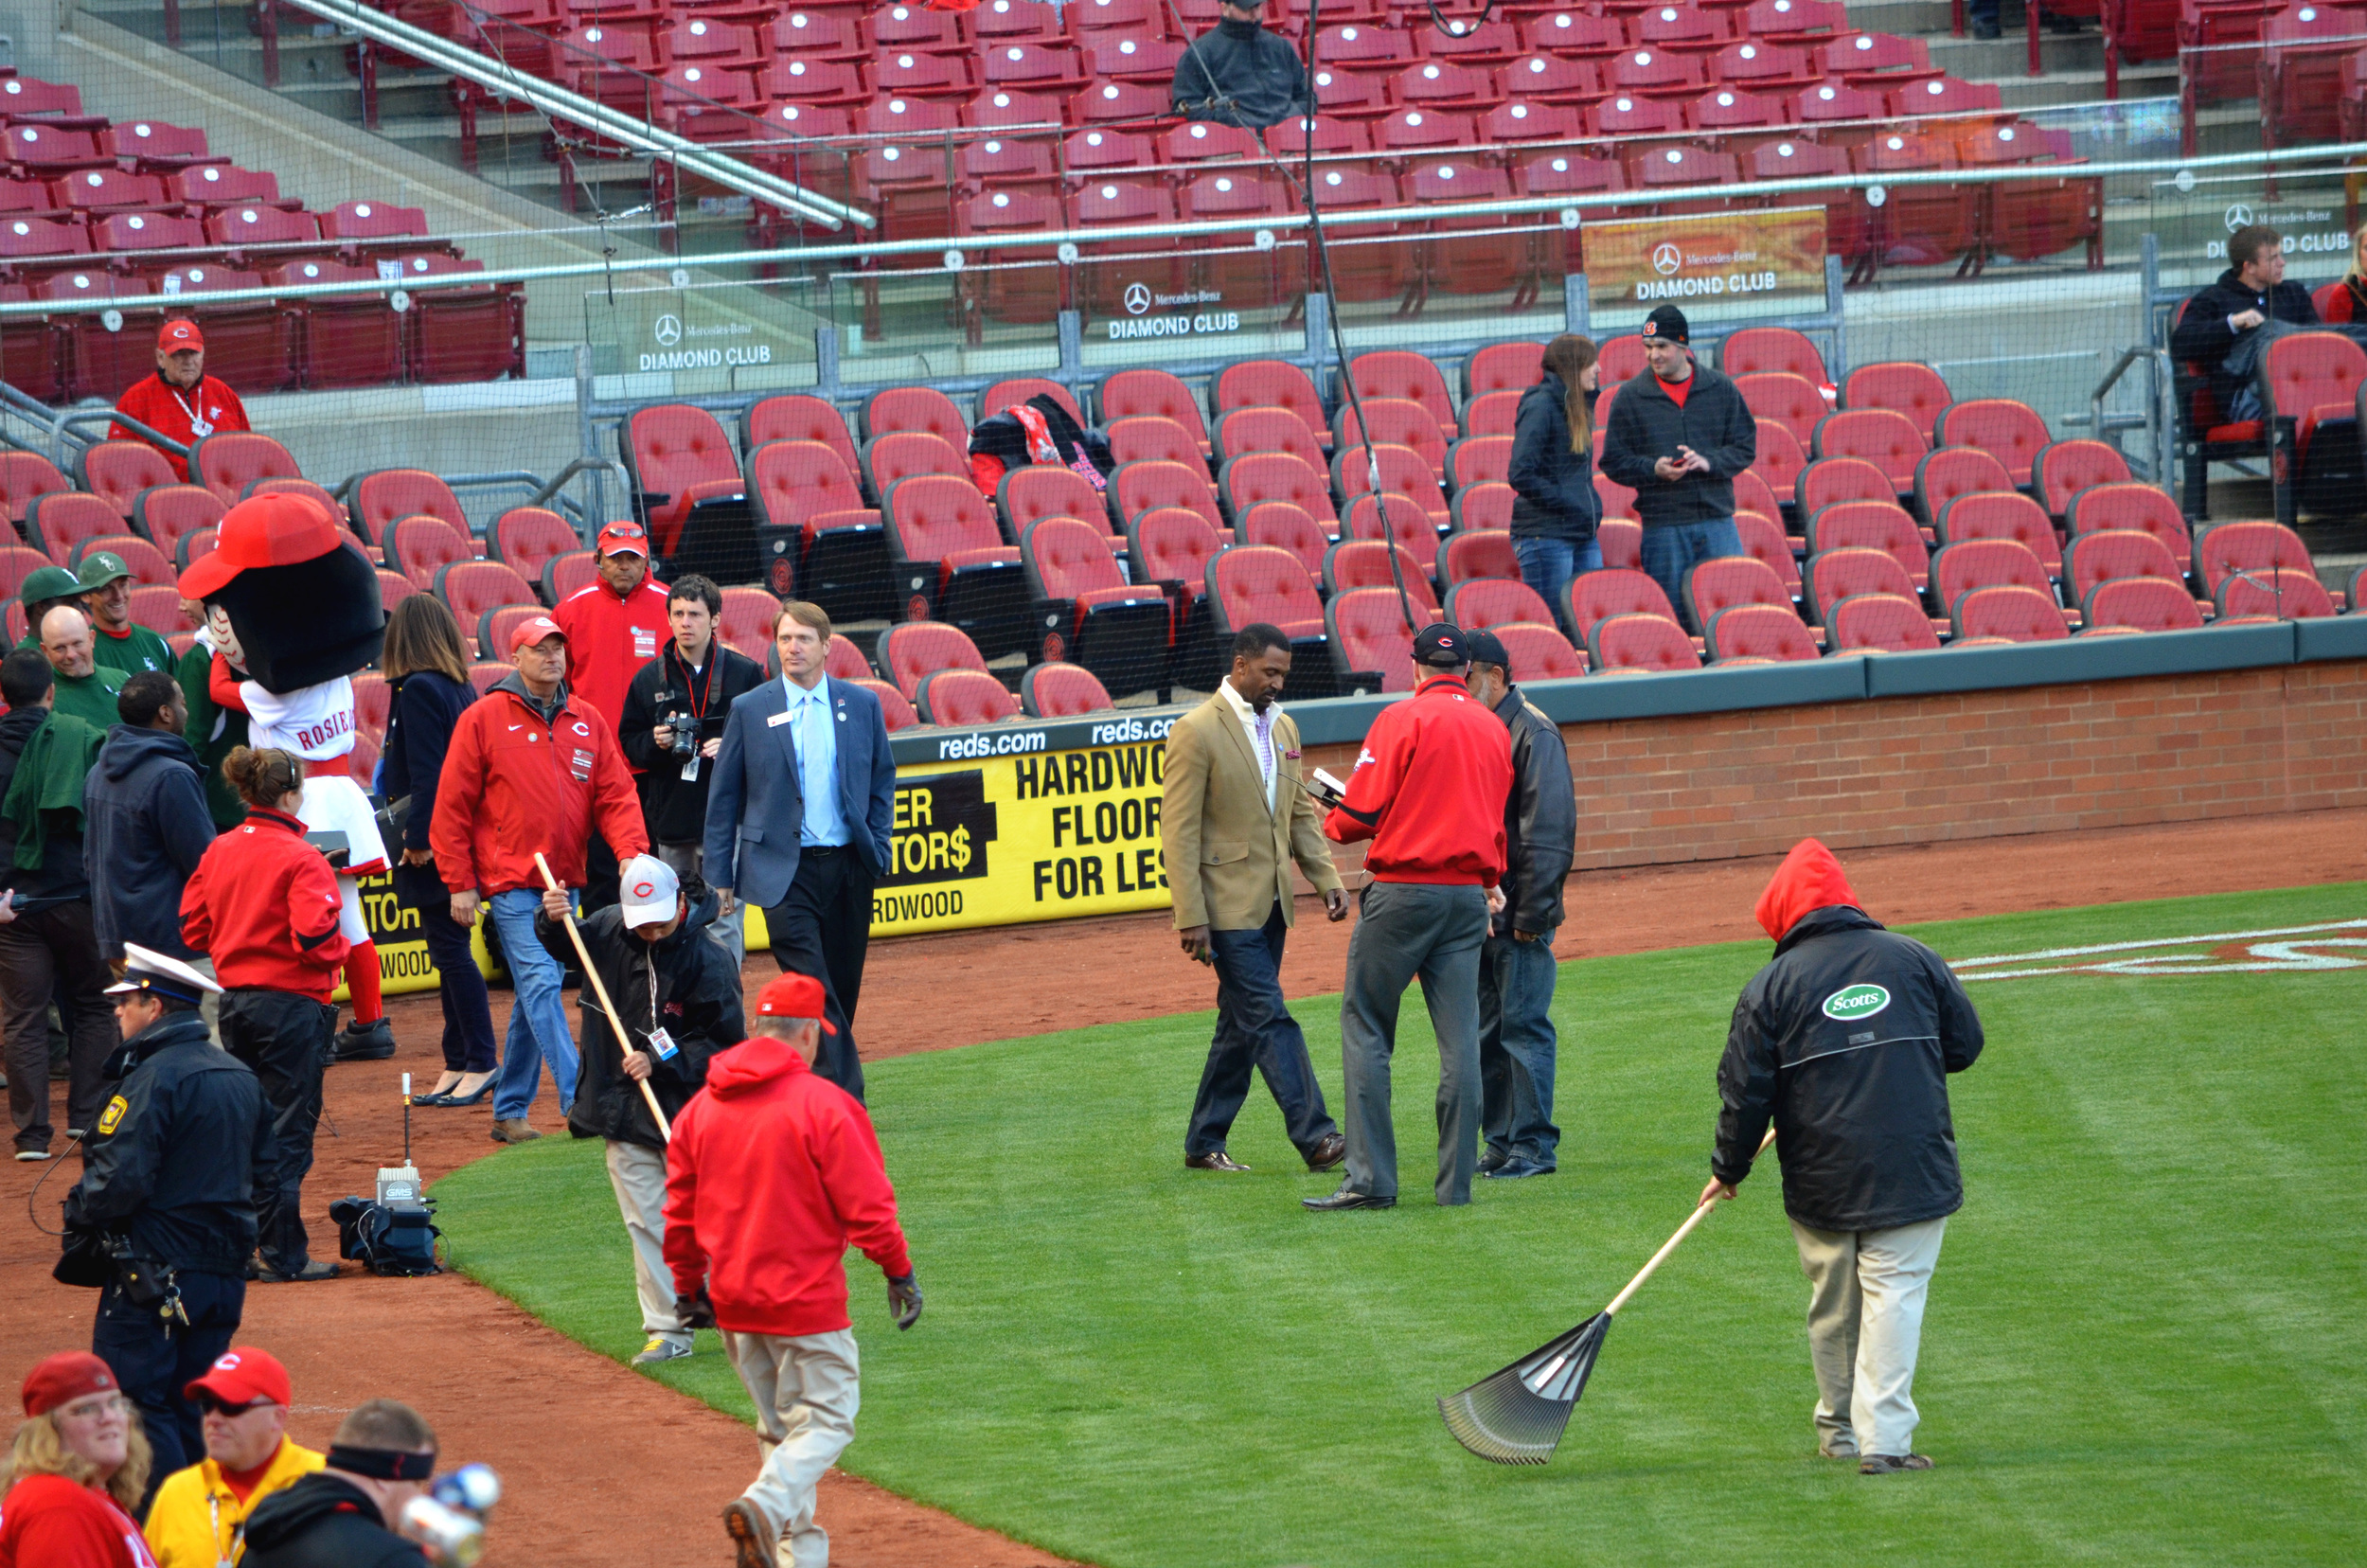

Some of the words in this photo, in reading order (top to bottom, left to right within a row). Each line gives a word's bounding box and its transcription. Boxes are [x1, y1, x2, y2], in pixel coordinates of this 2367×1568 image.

[2300, 232, 2350, 253] CLUB
[1154, 290, 1221, 307] Mercedes-Benz
[1636, 276, 1724, 300] DIAMOND
[1728, 272, 1777, 293] CLUB
[1109, 316, 1190, 340] DIAMOND
[1193, 312, 1239, 332] CLUB
[639, 348, 721, 371] DIAMOND
[725, 345, 772, 365] CLUB
[296, 710, 349, 751] ROSIE
[939, 730, 1045, 759] reds.com
[1091, 717, 1176, 745] reds.co
[1014, 743, 1166, 800] HARDWO
[1052, 796, 1164, 848] FLOOR
[1033, 855, 1105, 902] FOR
[870, 889, 963, 924] RDWOOD
[1832, 992, 1879, 1011] Scotts
[386, 1187, 413, 1197] GMS
